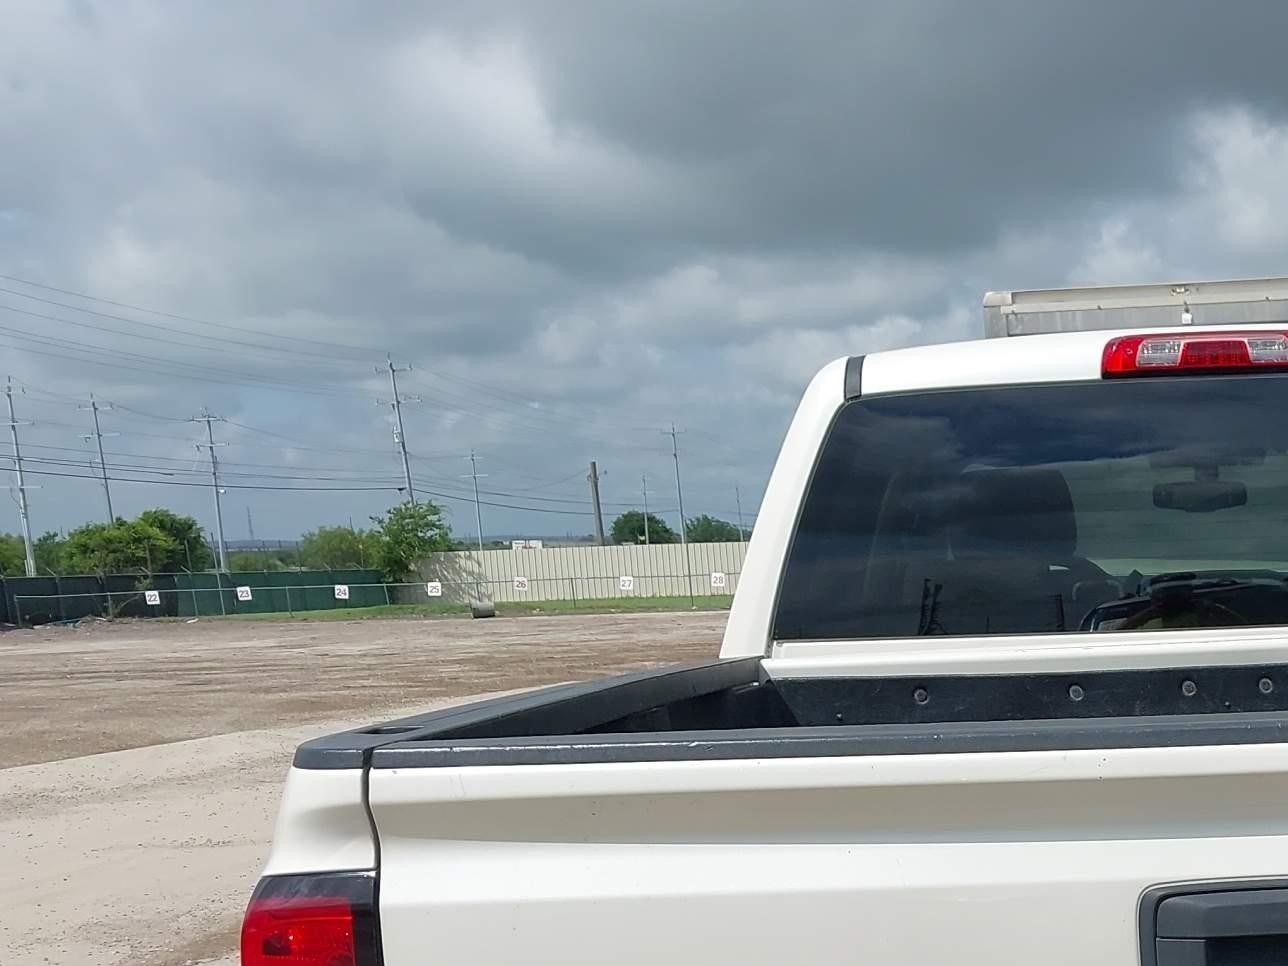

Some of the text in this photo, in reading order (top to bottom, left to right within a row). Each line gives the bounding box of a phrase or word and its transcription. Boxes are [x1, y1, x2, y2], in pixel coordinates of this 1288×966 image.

[515, 579, 527, 589] 26
[713, 576, 724, 584] 28
[239, 589, 250, 598] 23
[336, 588, 347, 597] 24
[429, 585, 440, 594] 25
[147, 593, 158, 602] 22
